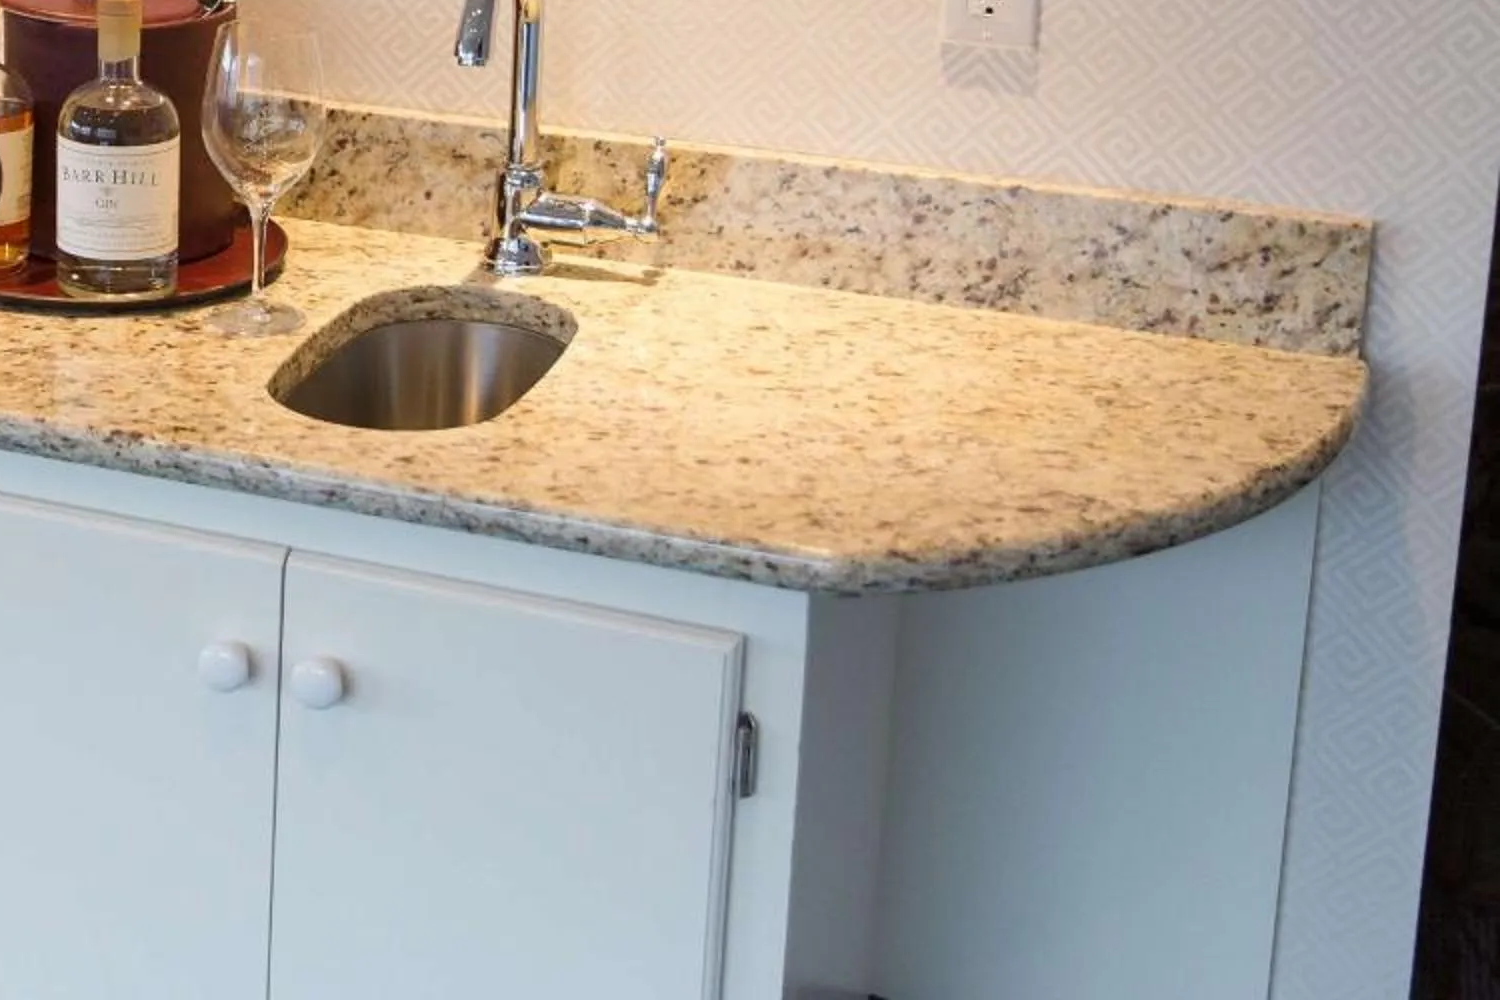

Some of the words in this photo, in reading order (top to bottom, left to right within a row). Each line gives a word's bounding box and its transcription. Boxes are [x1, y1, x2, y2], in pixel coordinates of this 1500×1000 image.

[63, 166, 105, 183] BARR
[112, 169, 159, 186] HILL
[95, 199, 117, 209] GIN
